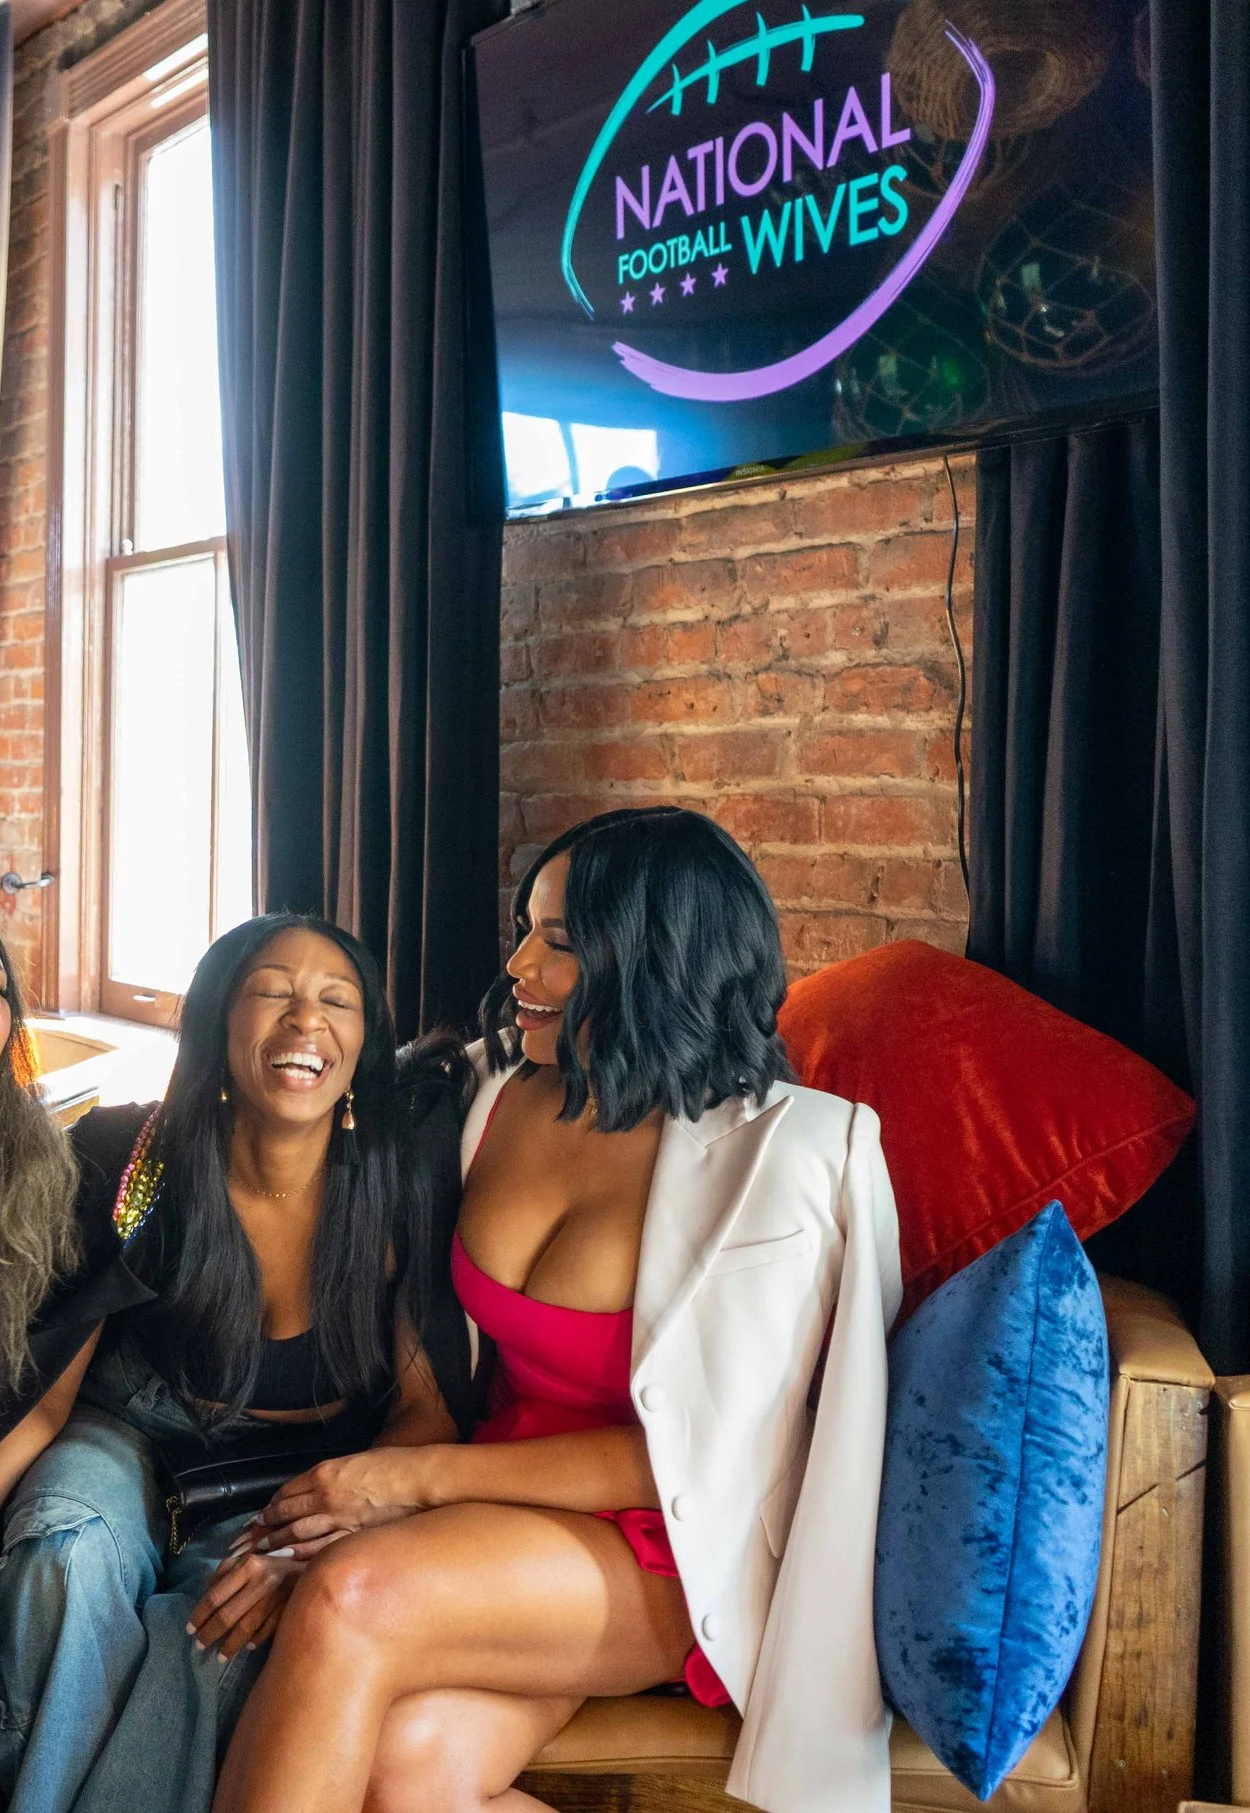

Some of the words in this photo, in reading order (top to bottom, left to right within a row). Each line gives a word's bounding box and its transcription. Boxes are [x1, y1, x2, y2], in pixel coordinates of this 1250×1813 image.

[615, 72, 911, 239] NATIONAL
[617, 223, 732, 285] FOOTBALL
[741, 164, 908, 275] WIVES
